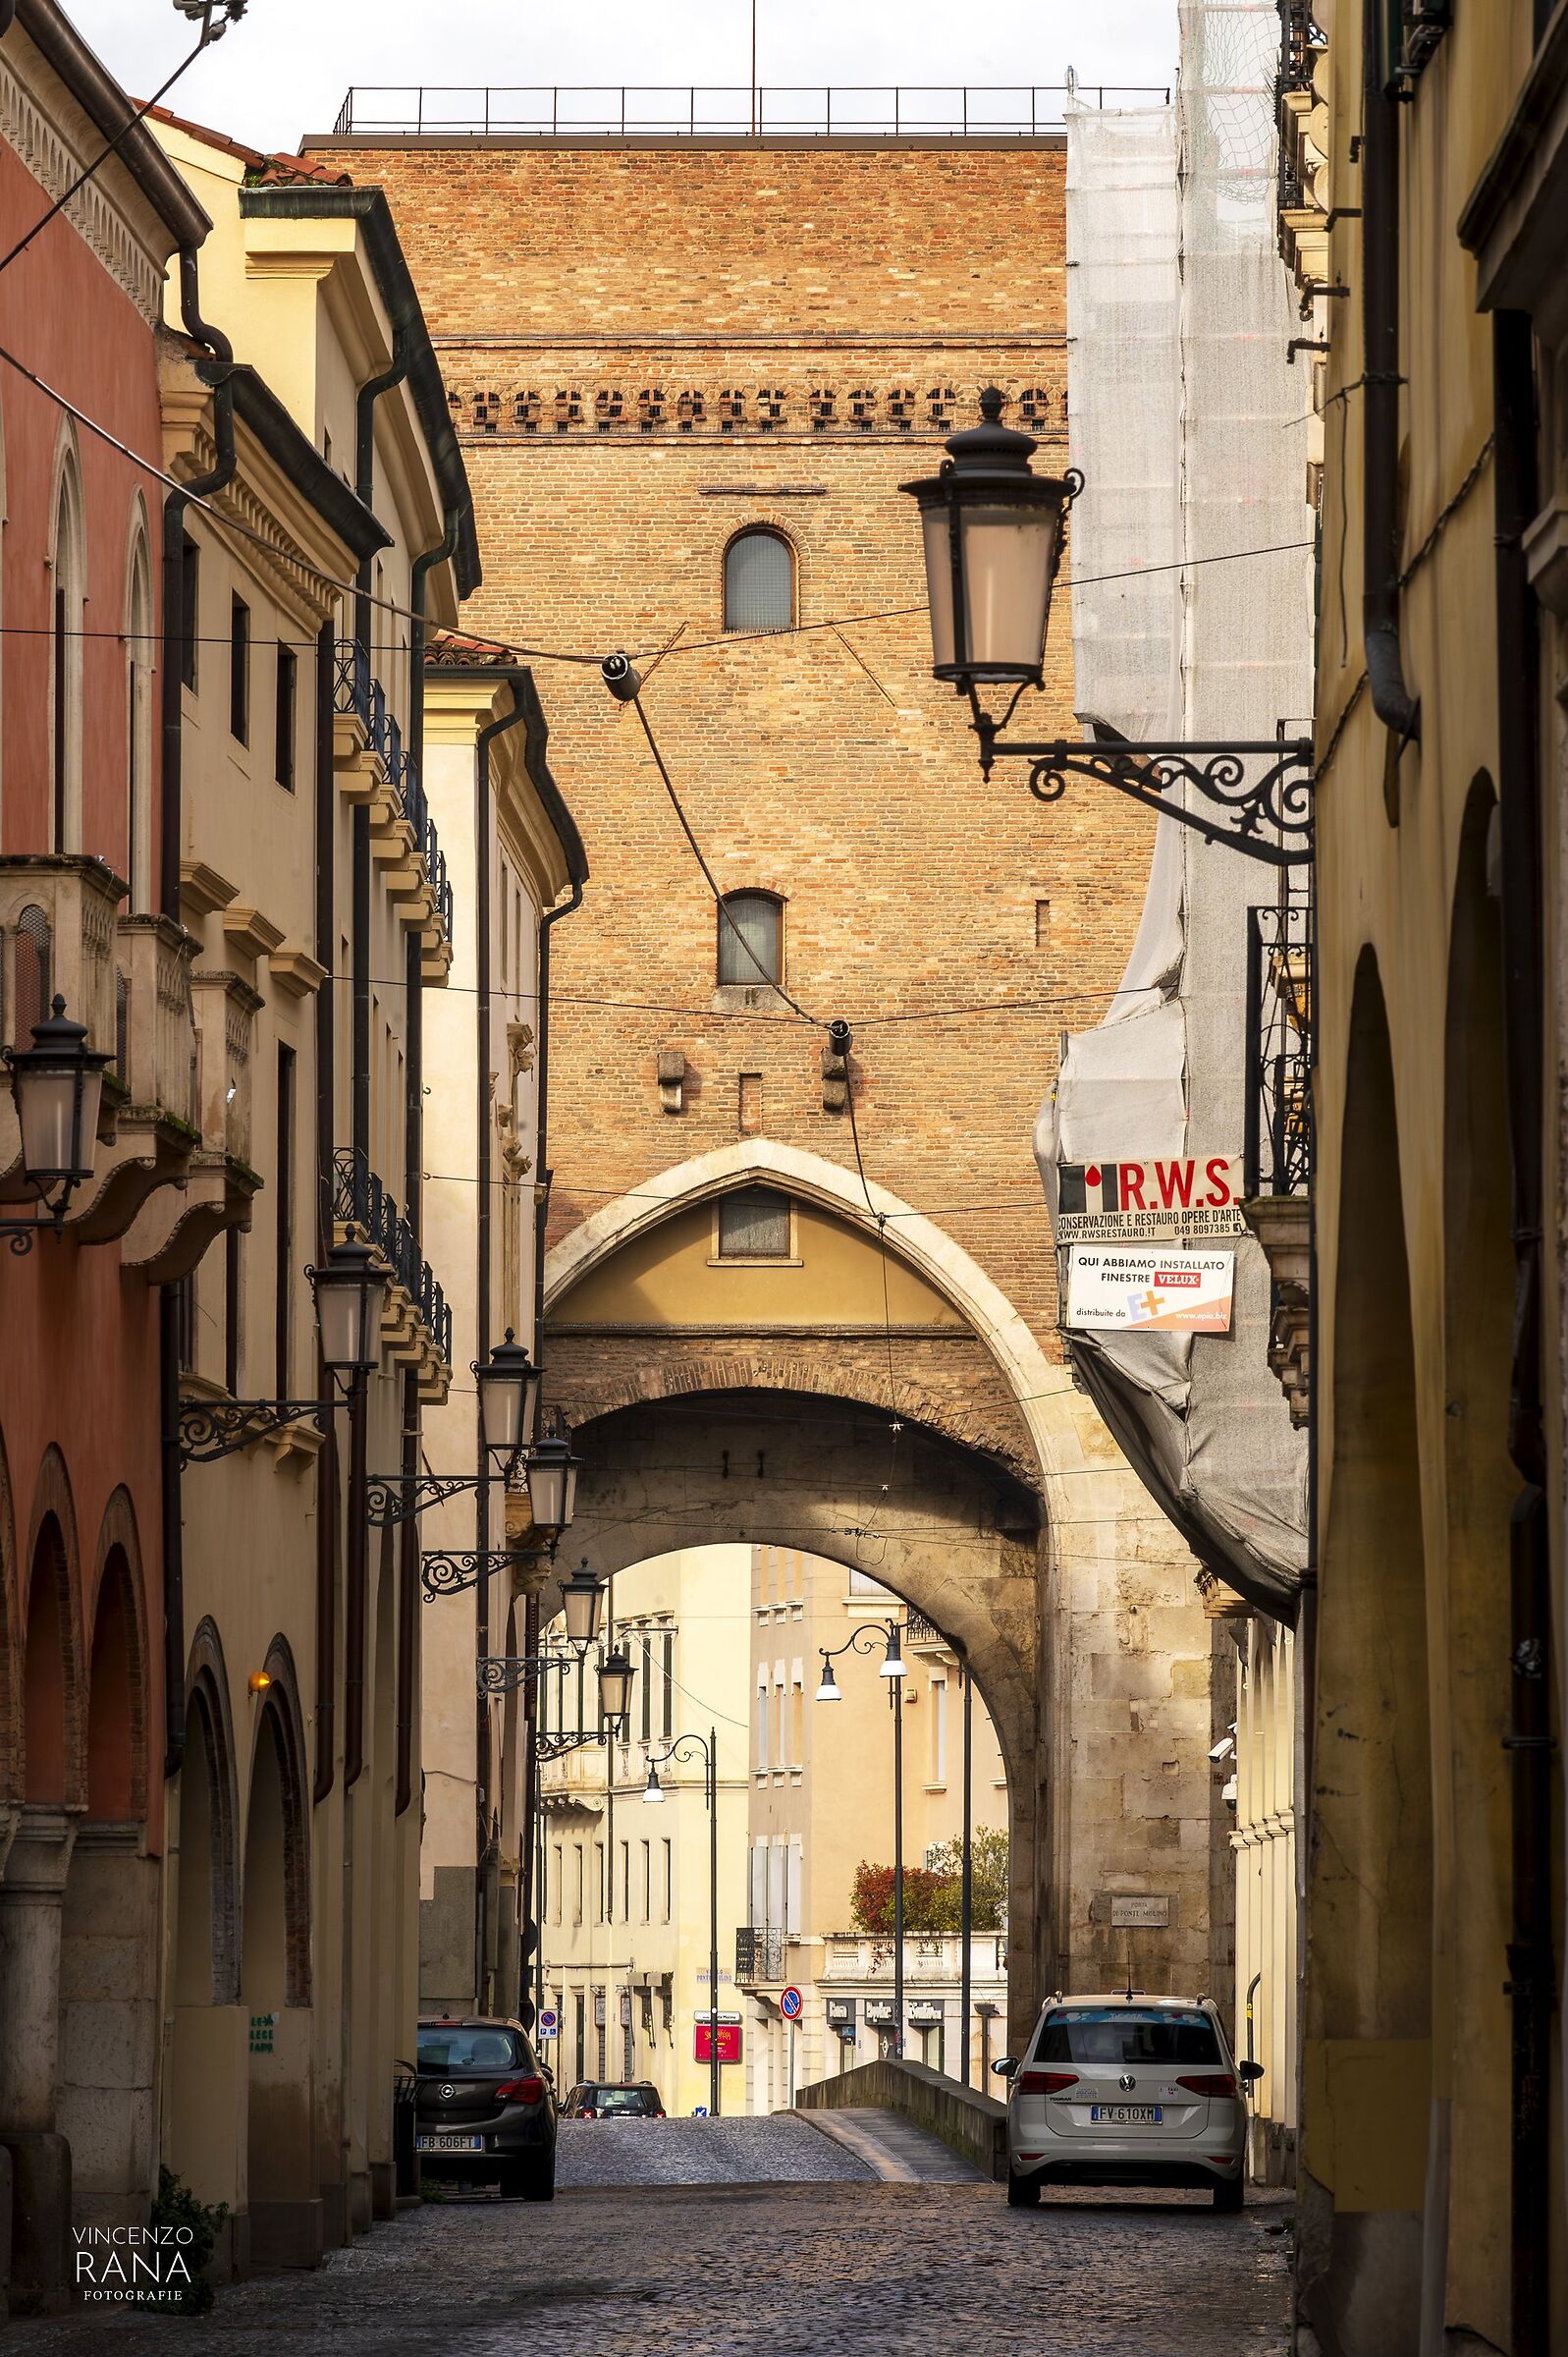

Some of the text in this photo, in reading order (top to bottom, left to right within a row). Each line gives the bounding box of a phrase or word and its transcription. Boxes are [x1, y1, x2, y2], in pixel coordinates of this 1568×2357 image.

[1118, 1158, 1240, 1212] R.W.S.
[1127, 1214, 1132, 1227] E
[1135, 1211, 1178, 1227] RESTAURO
[1181, 1210, 1210, 1225] OPERE
[1213, 1208, 1240, 1223] D'ARTE
[1174, 1225, 1190, 1235] 049
[1193, 1223, 1230, 1234] 8097385
[1078, 1256, 1225, 1271] QUI ABBIAMO INSTALLATO
[1101, 1272, 1198, 1286] FINESTRE VELUX
[1076, 1307, 1126, 1318] distribuite da
[1100, 2108, 1154, 2120] FV 610XM
[421, 2136, 473, 2148] FB 606FT
